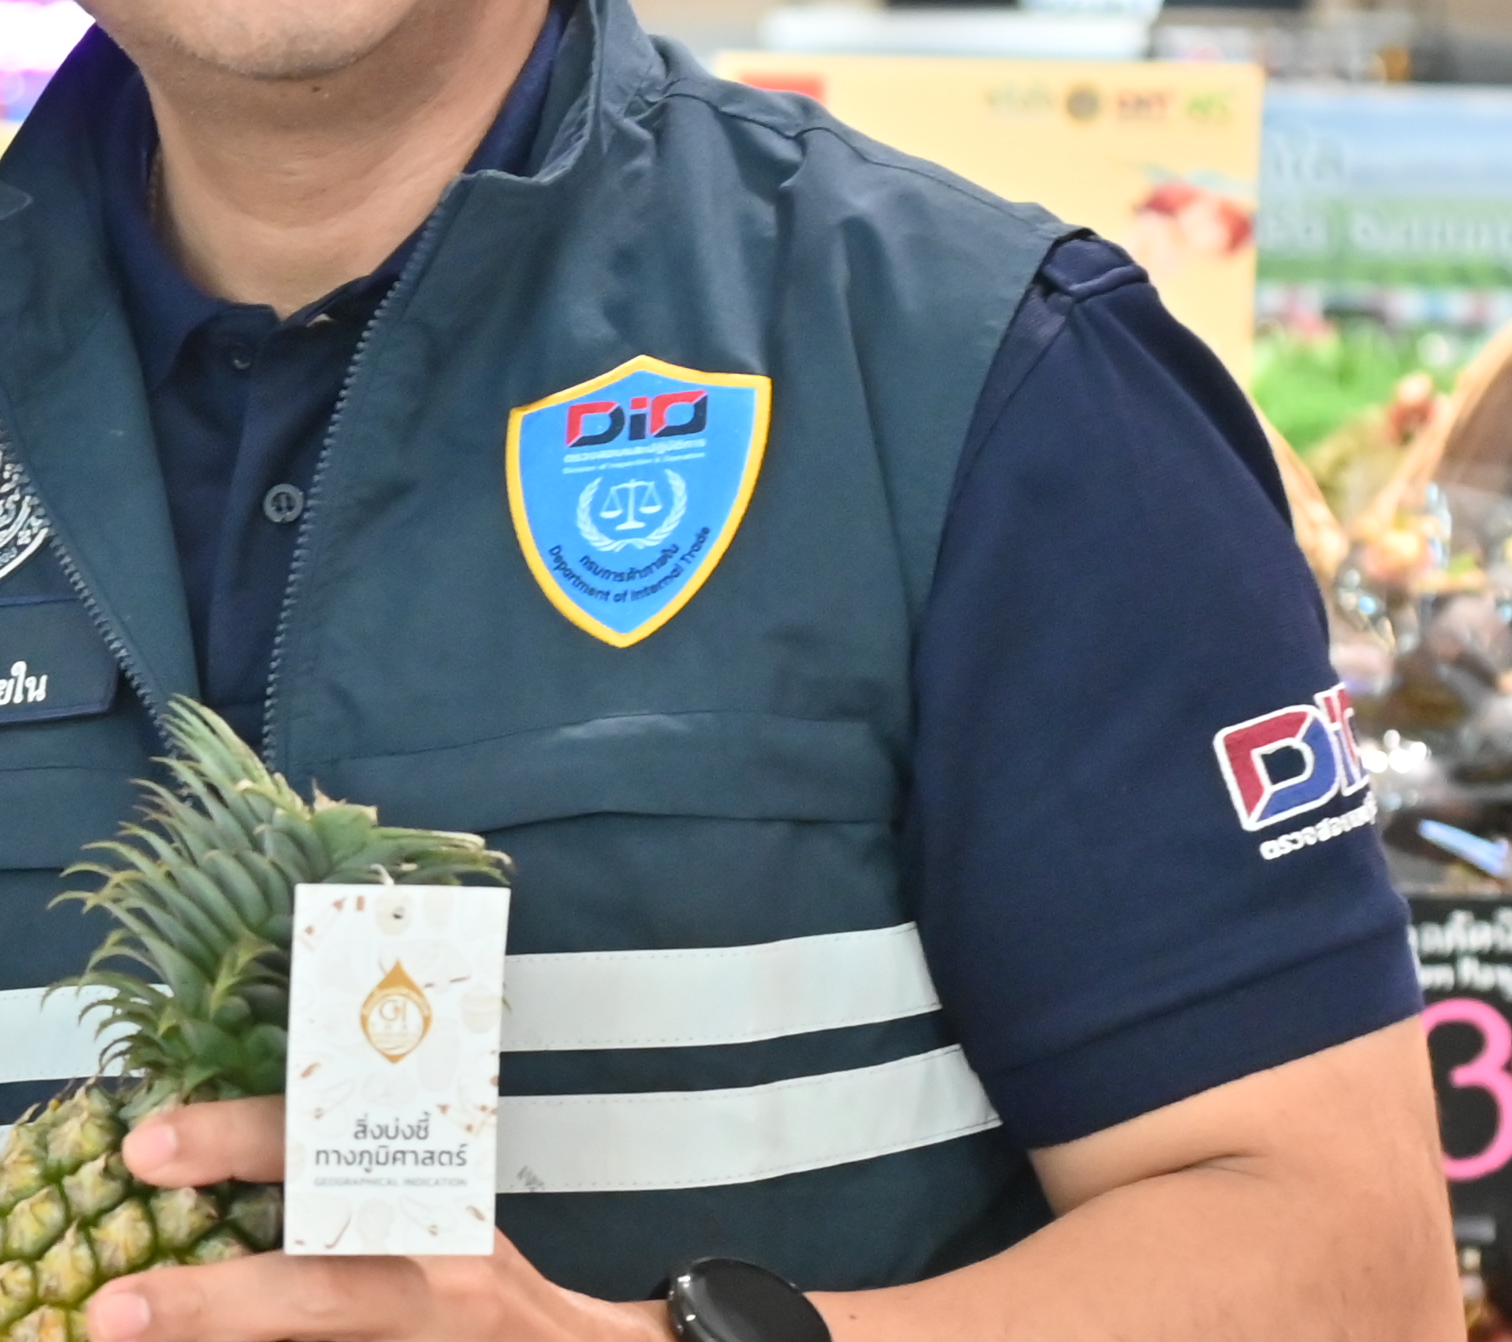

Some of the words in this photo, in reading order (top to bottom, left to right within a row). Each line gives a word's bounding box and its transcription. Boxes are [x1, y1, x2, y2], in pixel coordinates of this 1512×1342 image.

[548, 544, 612, 603] Department
[613, 589, 628, 603] of
[630, 563, 686, 602] Internal
[679, 526, 711, 565] Trade
[353, 1112, 431, 1142] สิ่งบ่งชี้
[314, 1143, 469, 1175] ทางภูมิศาสตร์
[313, 1177, 398, 1187] GEOGRAPHICAL
